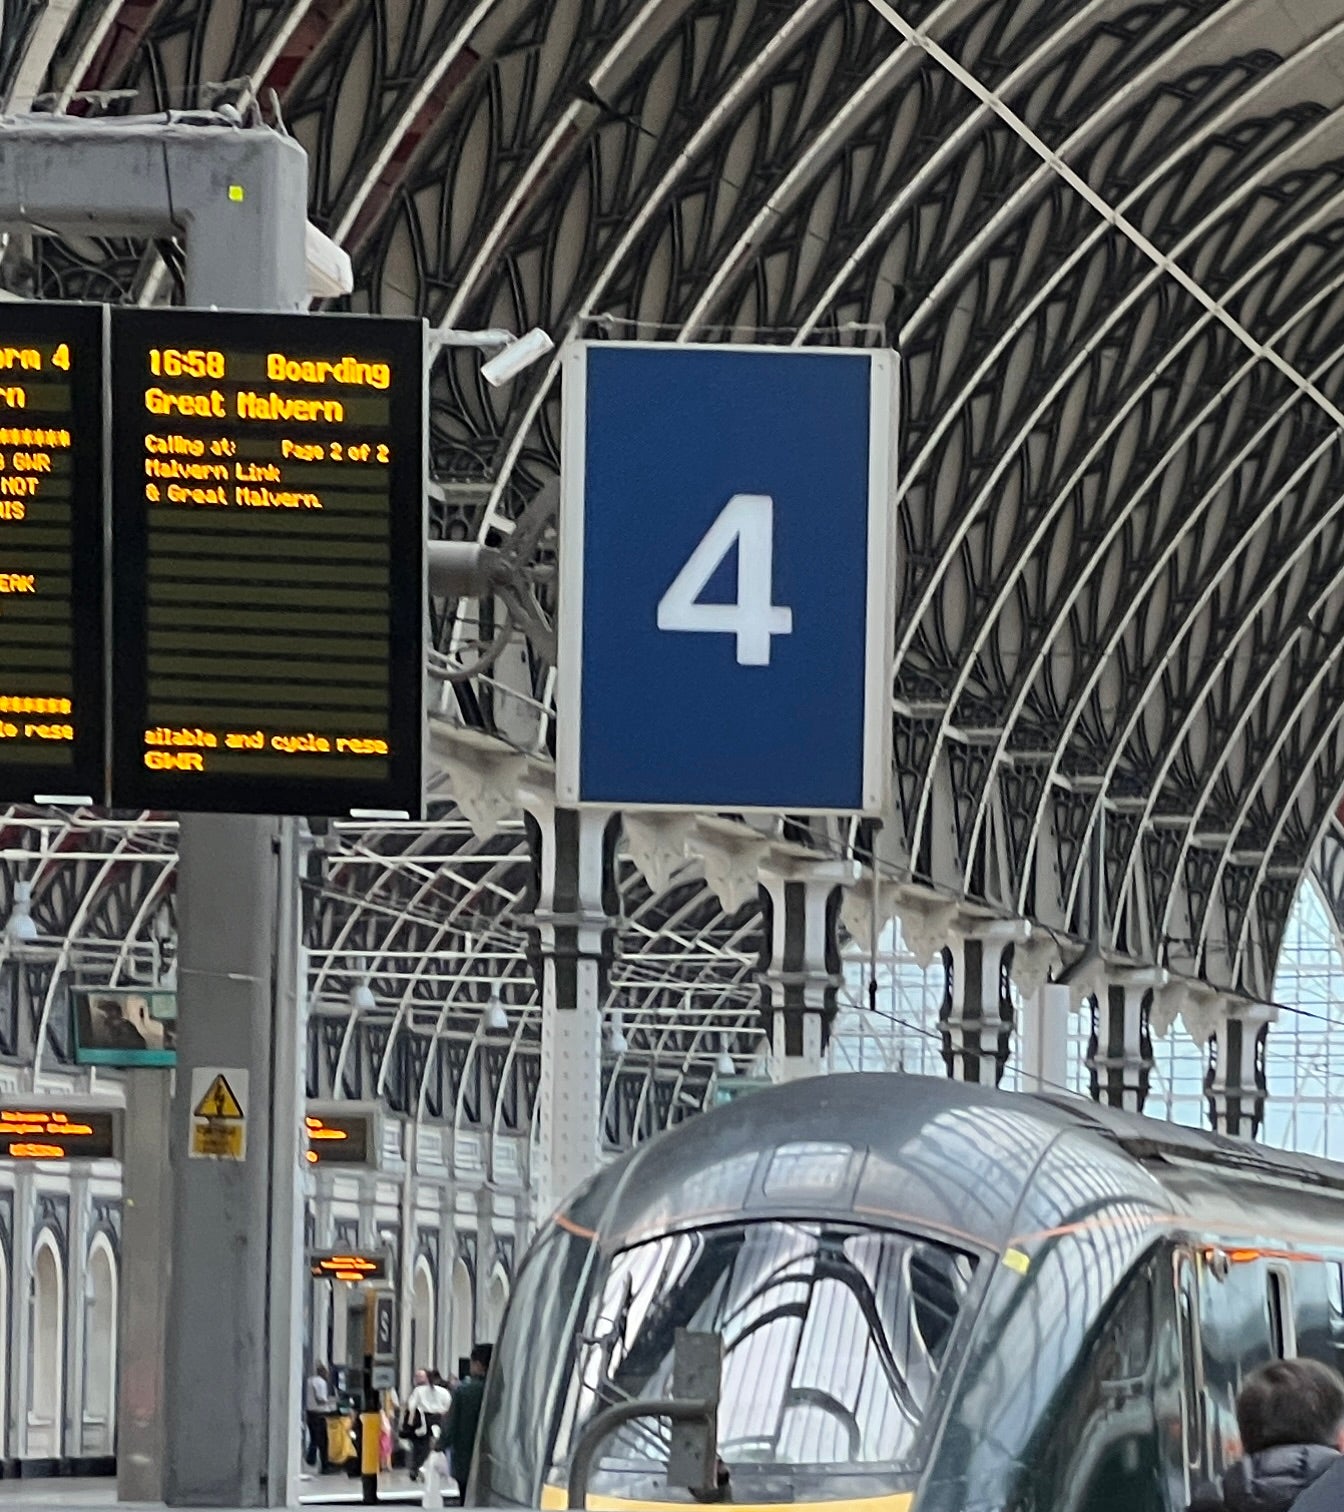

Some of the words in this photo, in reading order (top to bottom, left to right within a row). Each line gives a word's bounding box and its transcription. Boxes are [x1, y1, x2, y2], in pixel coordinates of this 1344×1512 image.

[51, 343, 71, 371] 4
[149, 349, 225, 379] 16:58
[267, 353, 390, 389] Boarding
[144, 387, 227, 418] Great
[236, 391, 344, 423] Malvern
[144, 434, 205, 457] Calling
[209, 437, 237, 457] at:
[281, 439, 325, 462] Page
[329, 441, 343, 461] 2
[347, 443, 371, 462] of
[376, 443, 390, 463] 2
[144, 458, 229, 481] Malvern
[235, 462, 281, 483] Link
[0, 476, 40, 497] NOT
[167, 483, 228, 506] Great
[657, 494, 793, 666] 4
[144, 727, 218, 748] ailable
[224, 730, 265, 749] and
[270, 733, 330, 753] cycle
[336, 738, 388, 754] rese
[144, 750, 204, 772] GWR
